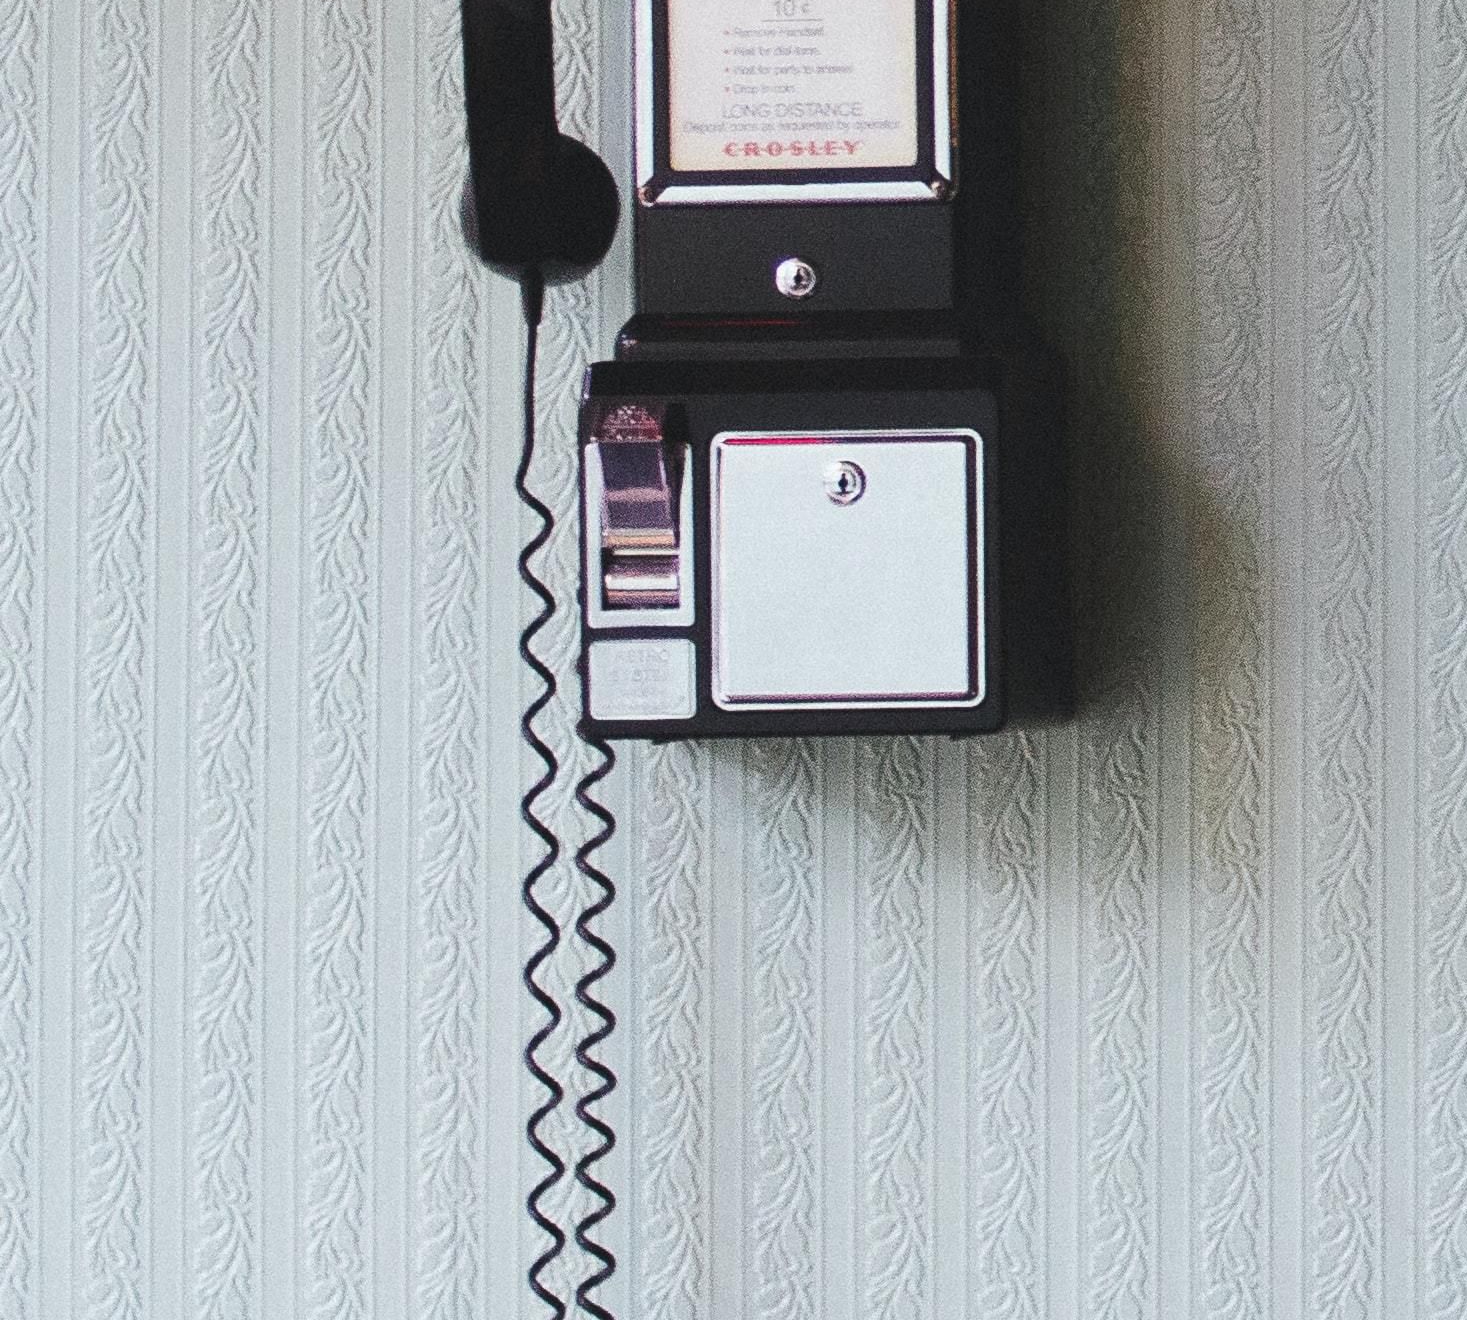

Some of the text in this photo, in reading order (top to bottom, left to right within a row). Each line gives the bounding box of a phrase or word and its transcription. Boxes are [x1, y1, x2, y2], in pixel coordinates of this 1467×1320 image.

[722, 101, 864, 119] LONG DISTANCE
[723, 140, 860, 157] CROSLEY
